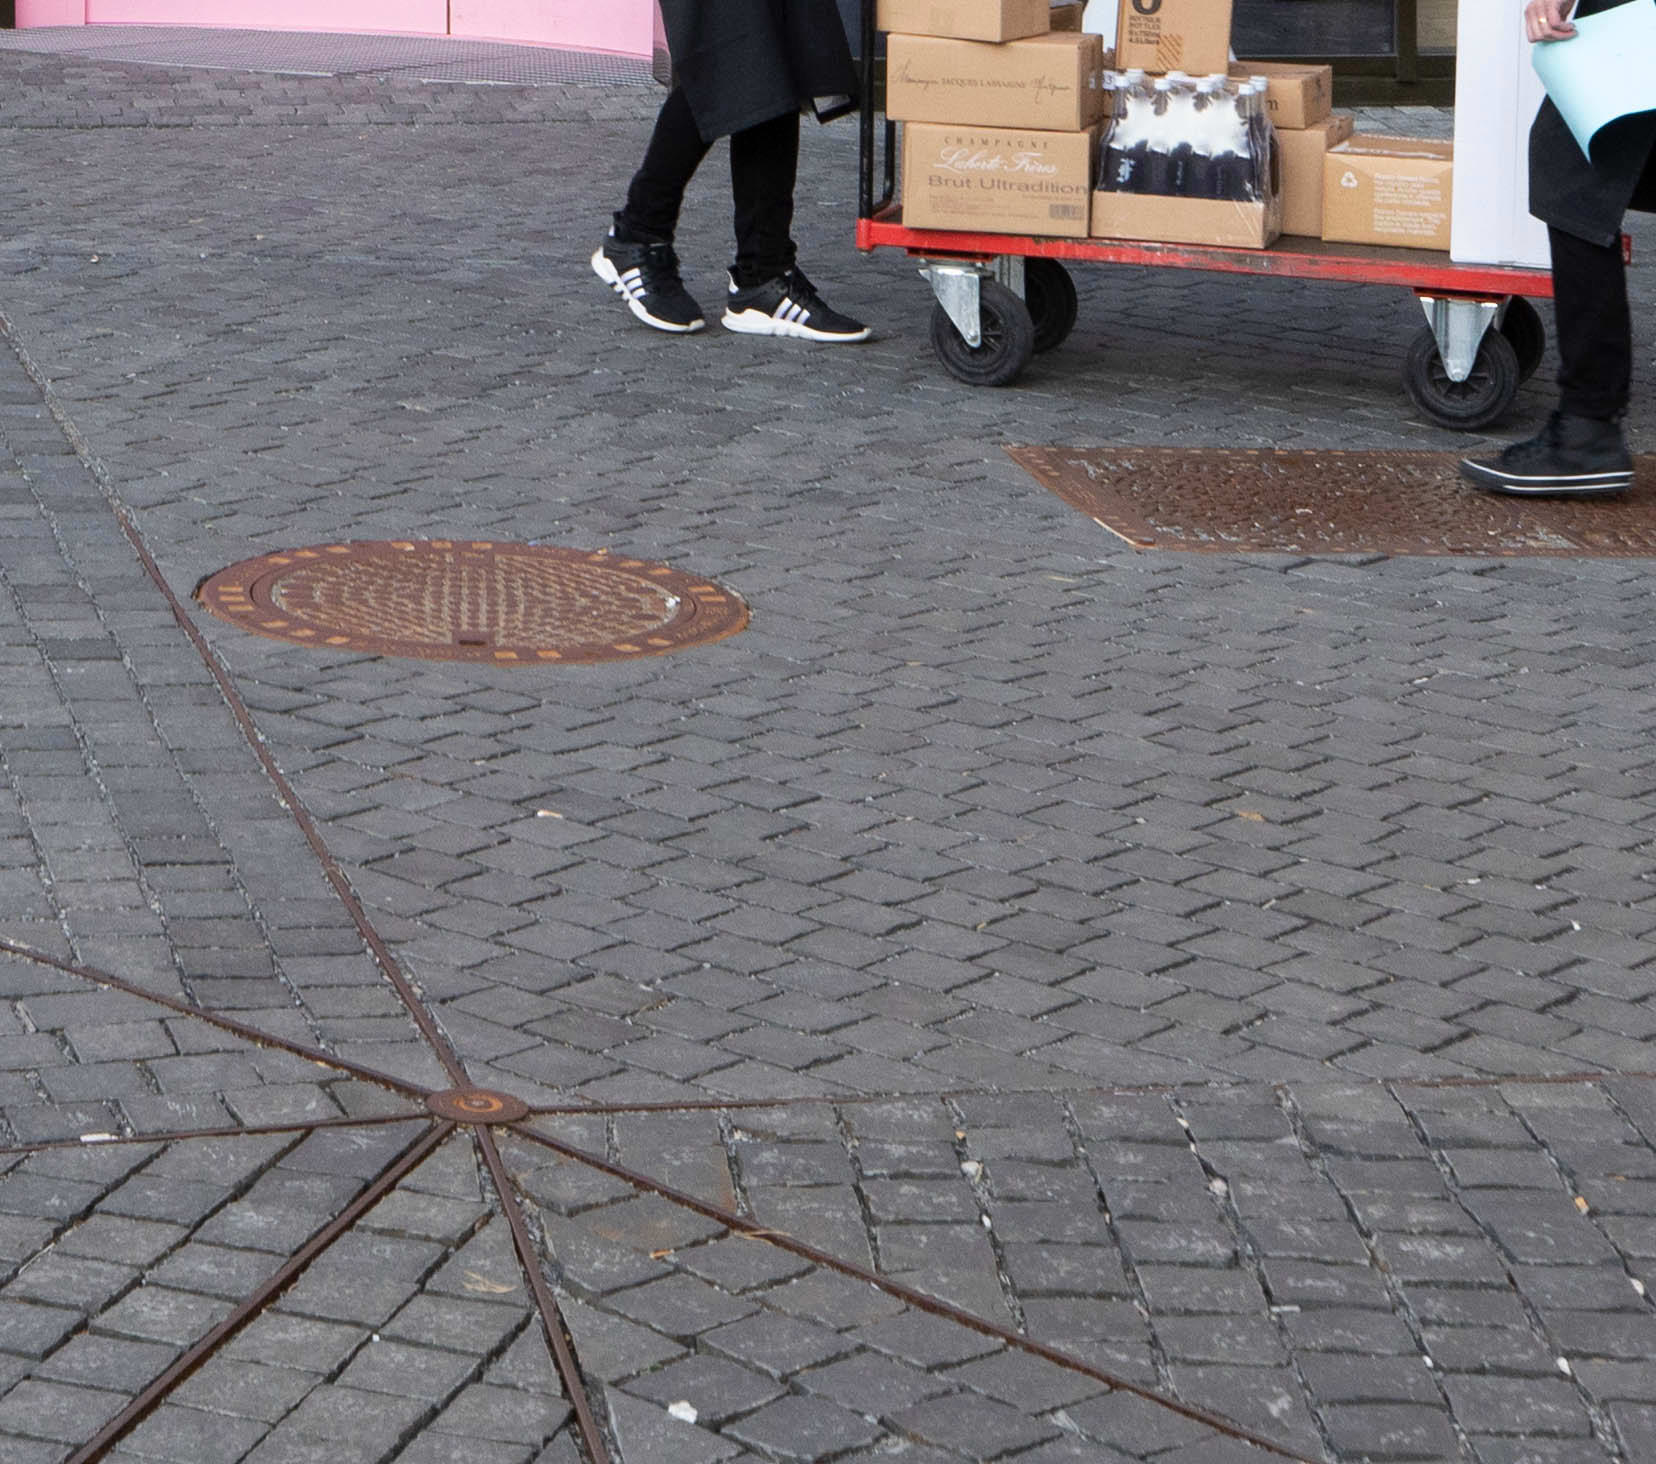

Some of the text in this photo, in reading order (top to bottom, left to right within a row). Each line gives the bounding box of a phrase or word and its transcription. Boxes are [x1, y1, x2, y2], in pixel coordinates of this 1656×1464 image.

[944, 136, 1049, 149] CHAMPAGNE
[928, 175, 1088, 195] Brut Ultradition
